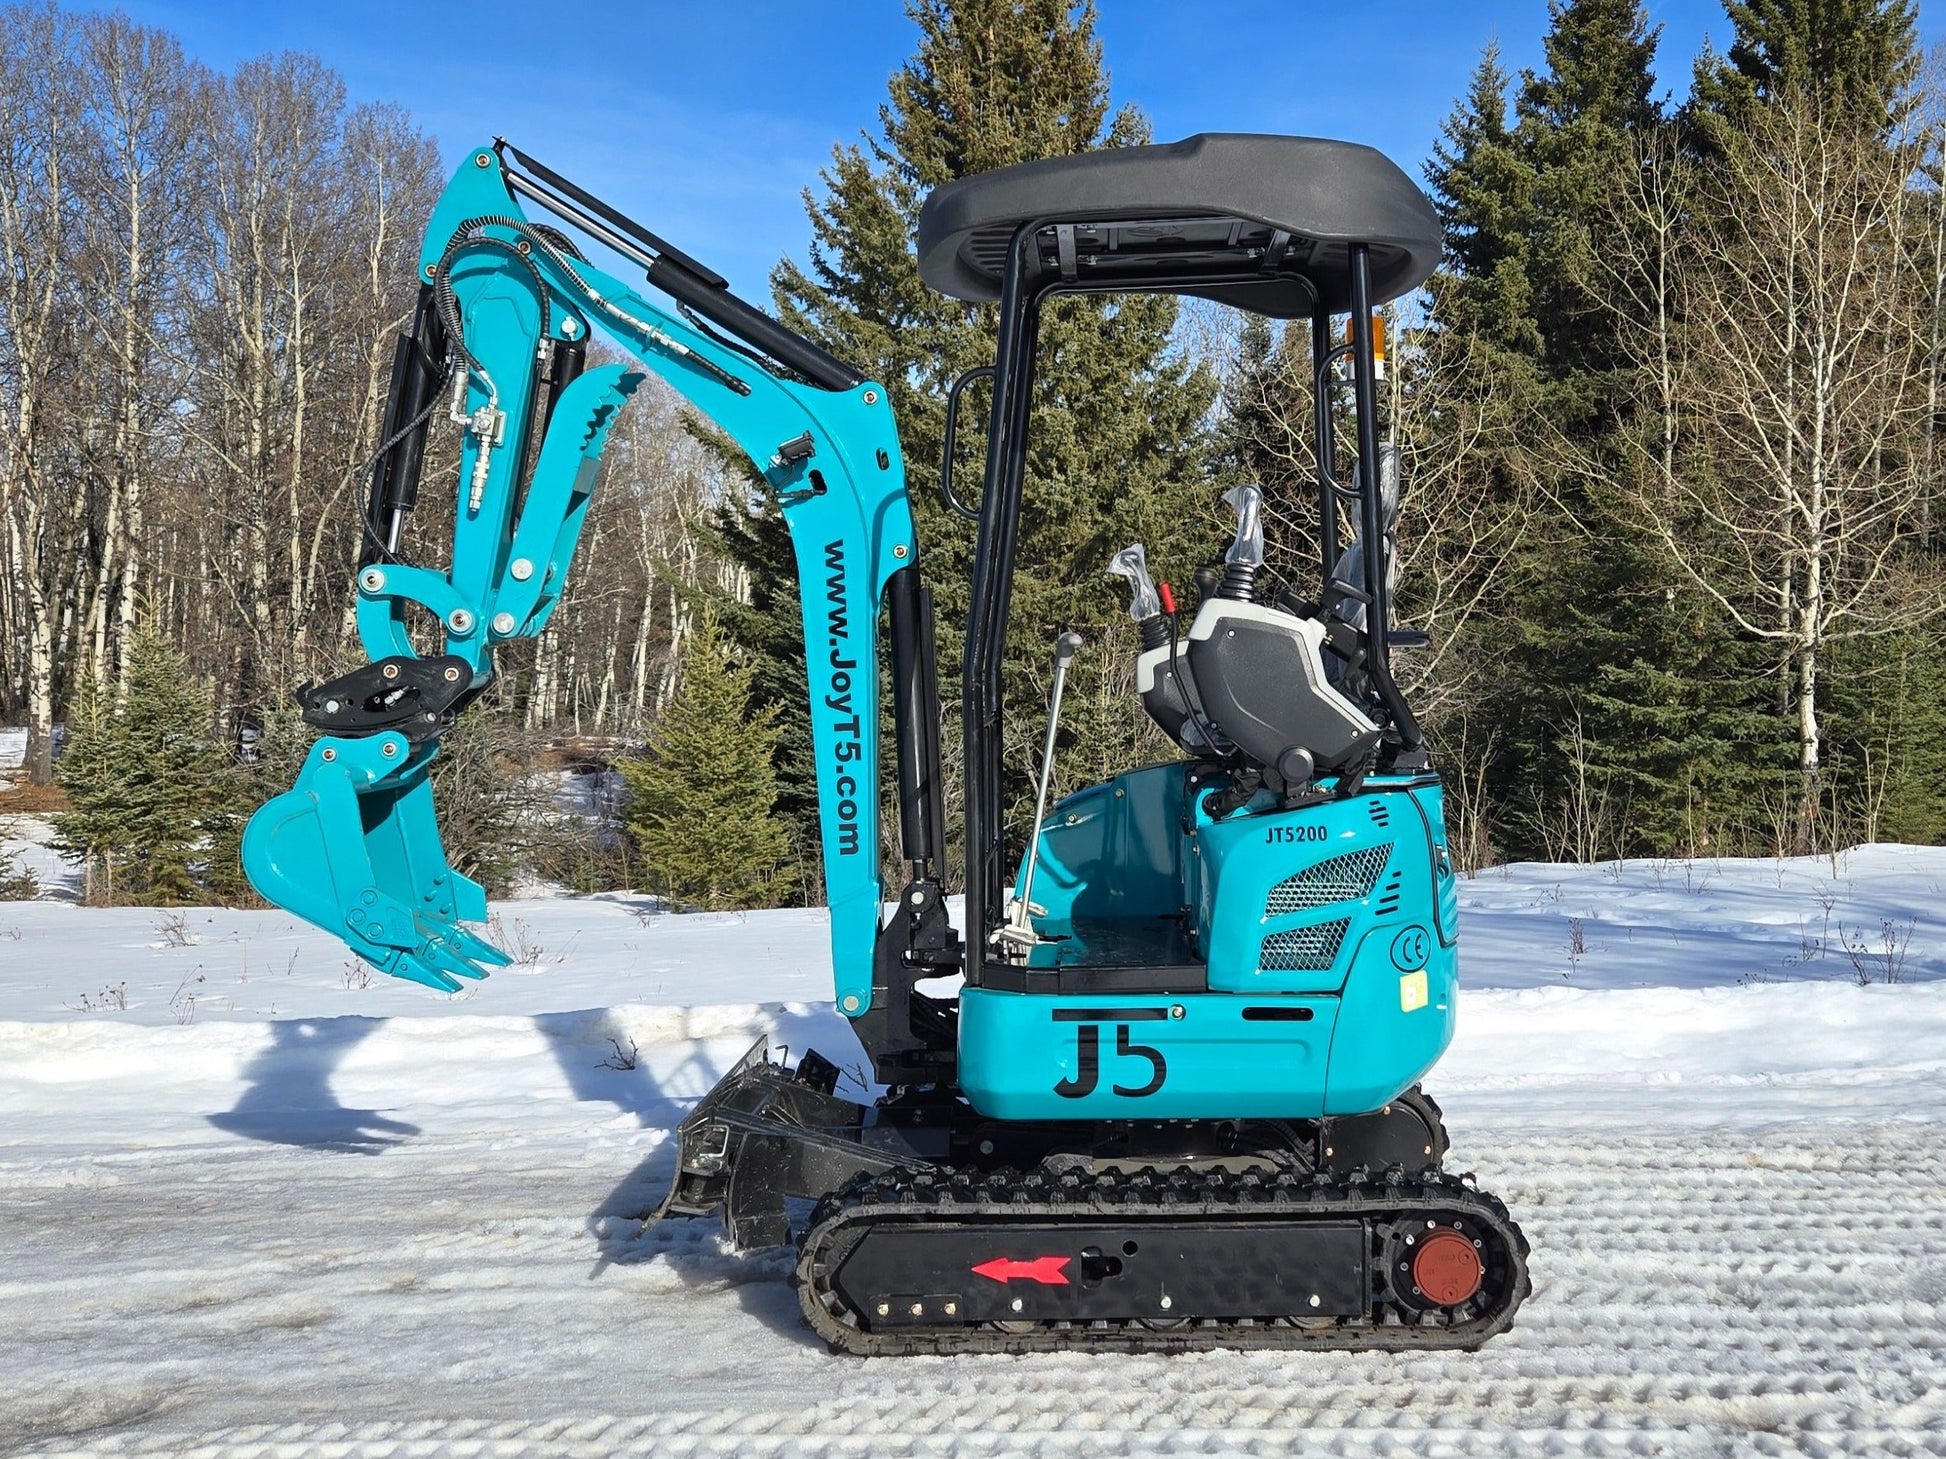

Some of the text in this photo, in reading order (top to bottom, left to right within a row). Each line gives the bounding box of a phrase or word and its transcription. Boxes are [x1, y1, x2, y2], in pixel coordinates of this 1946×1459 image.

[824, 539, 862, 856] www.JoyT5.com
[1265, 826, 1328, 844] JT5200
[1402, 933, 1424, 963] CE
